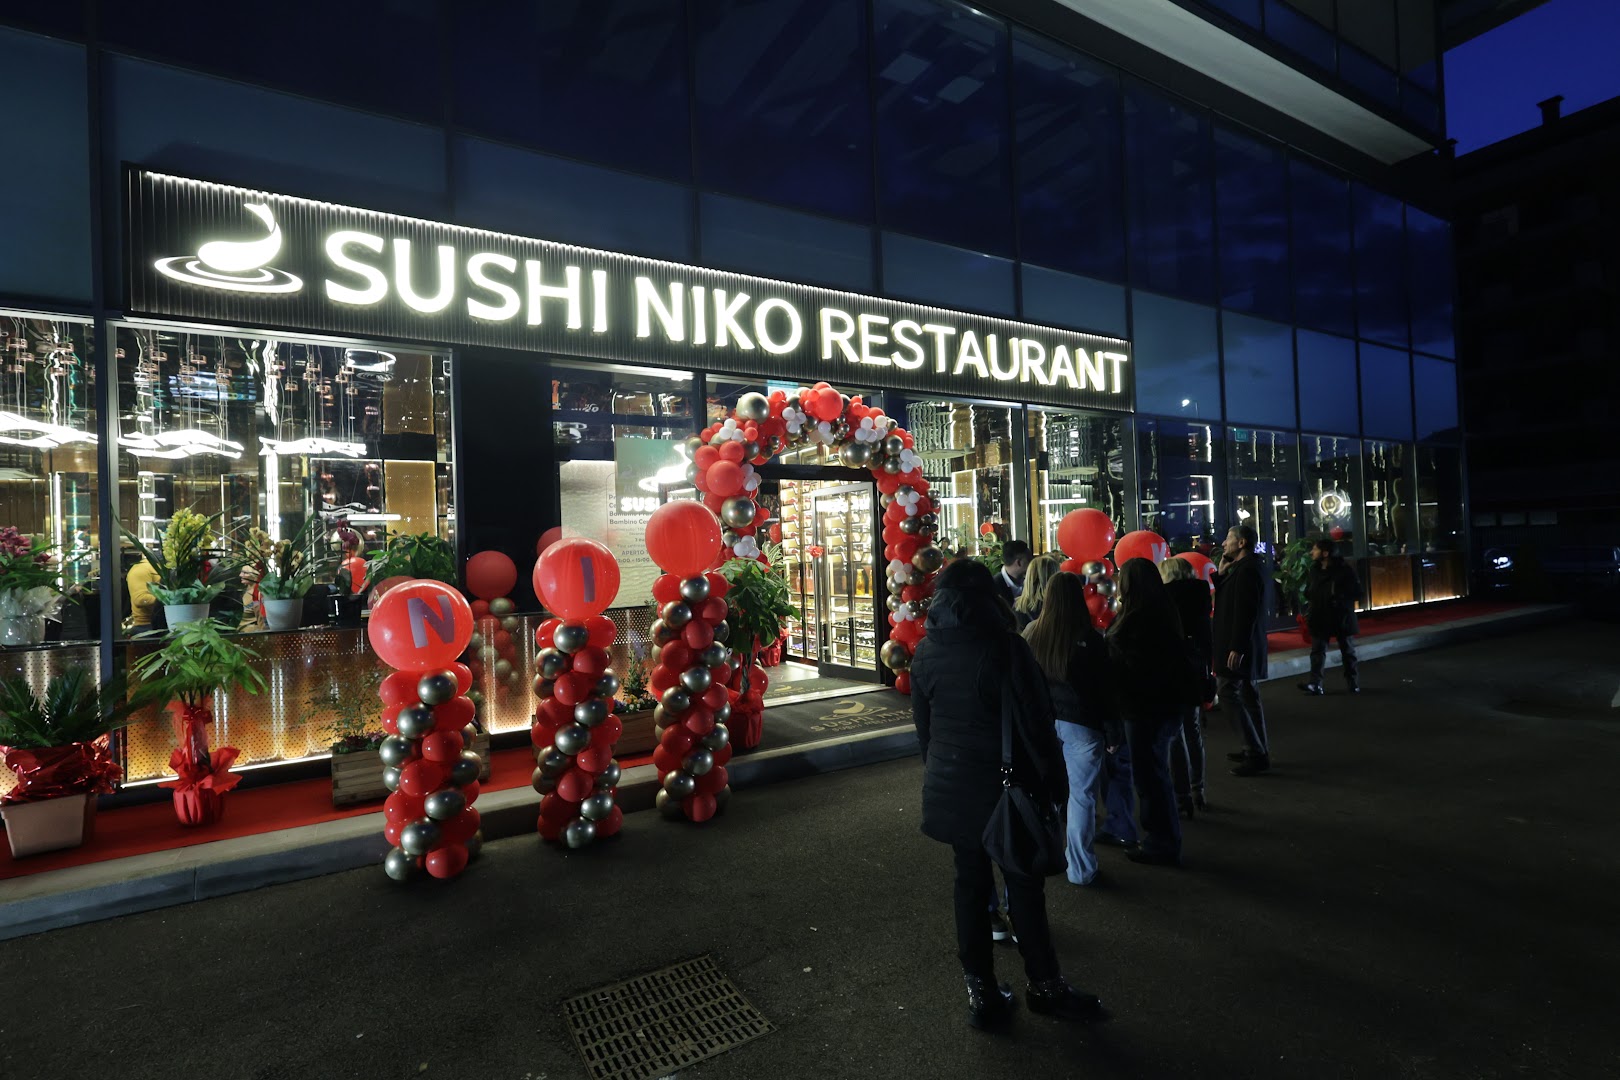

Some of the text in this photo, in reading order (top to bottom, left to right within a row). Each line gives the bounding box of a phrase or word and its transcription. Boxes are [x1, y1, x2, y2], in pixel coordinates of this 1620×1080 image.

[324, 229, 1128, 394] SUSHI NIKO RESTAURANT
[407, 594, 455, 649] N
[810, 714, 875, 732] SUSHI
